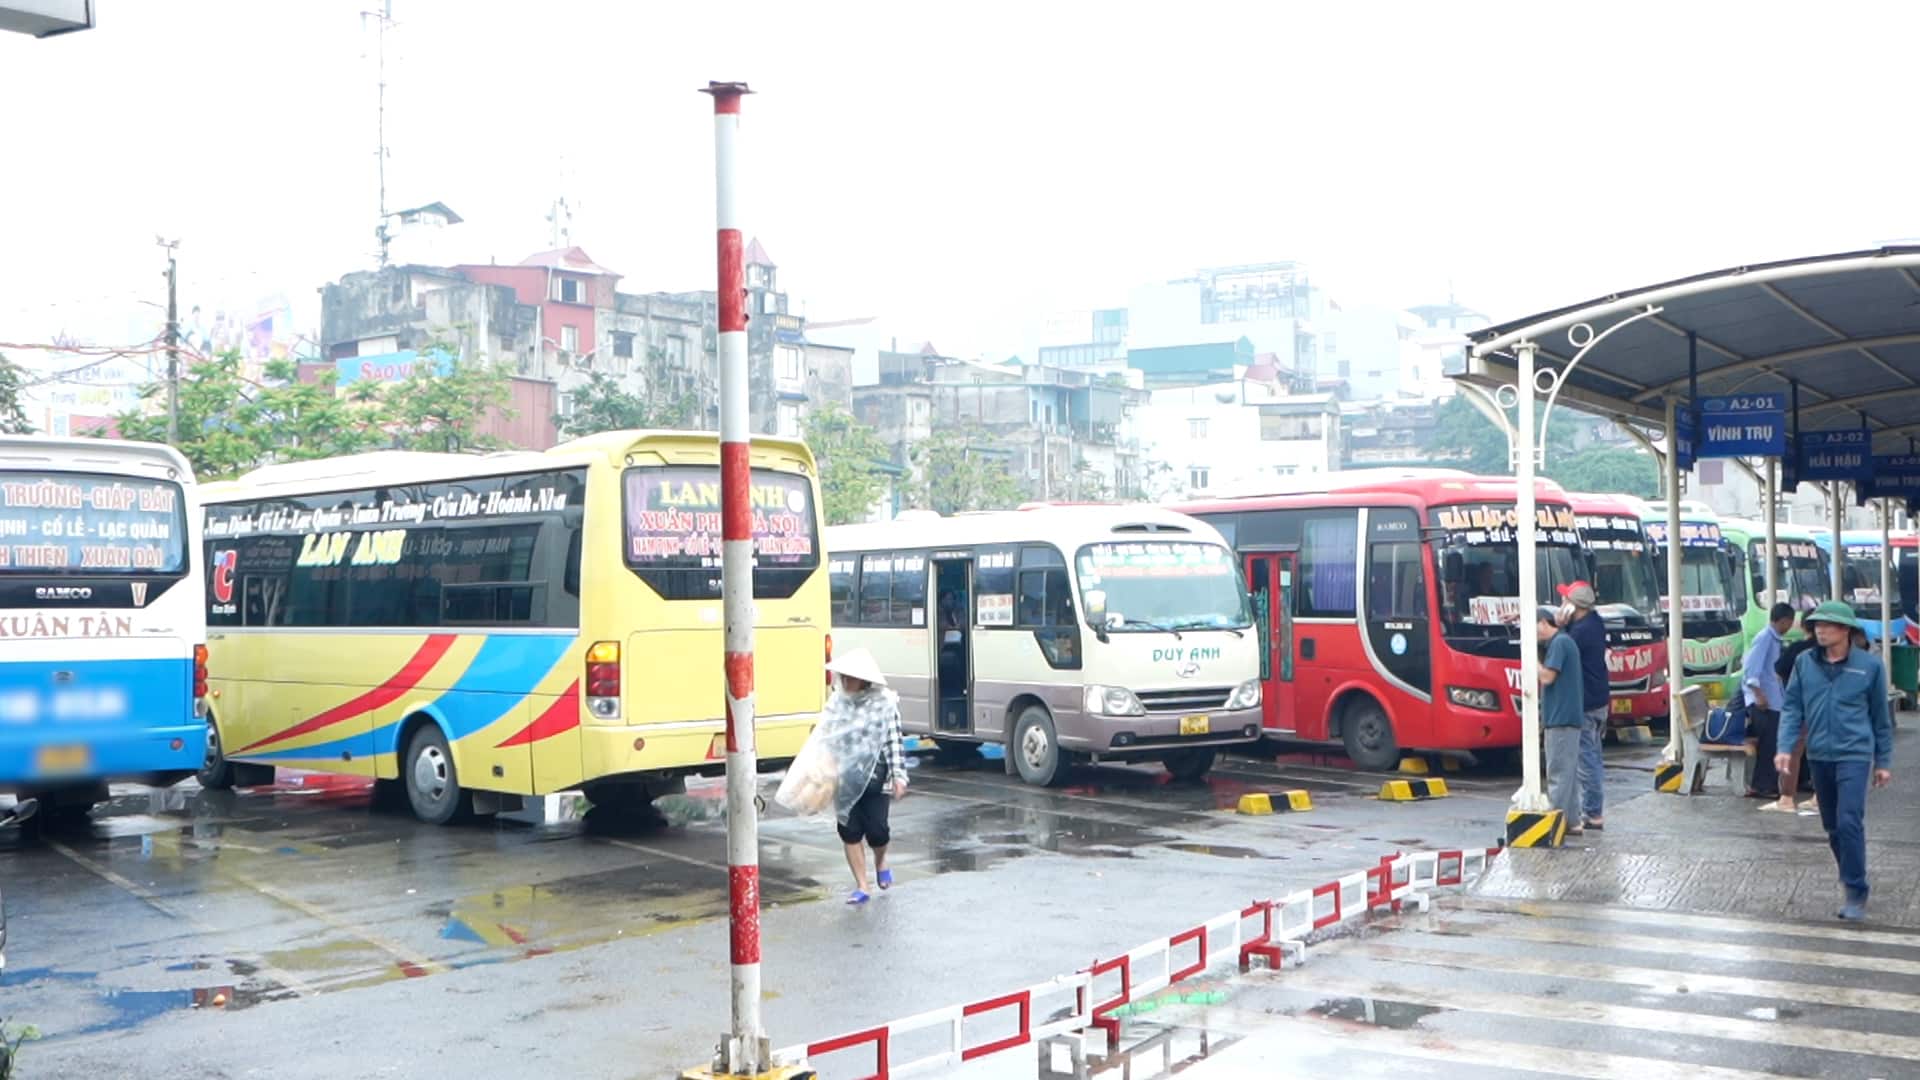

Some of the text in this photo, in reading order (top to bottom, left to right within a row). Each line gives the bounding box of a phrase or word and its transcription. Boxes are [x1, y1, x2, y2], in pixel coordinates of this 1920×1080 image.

[1729, 397, 1775, 410] A2-01
[1745, 425, 1773, 442] TRỤ
[749, 484, 784, 508] NH
[296, 531, 351, 567] LAN
[350, 529, 405, 566] ANH
[36, 587, 93, 600] SAMCO
[79, 610, 132, 637] TÂN
[1190, 647, 1220, 660] ANH
